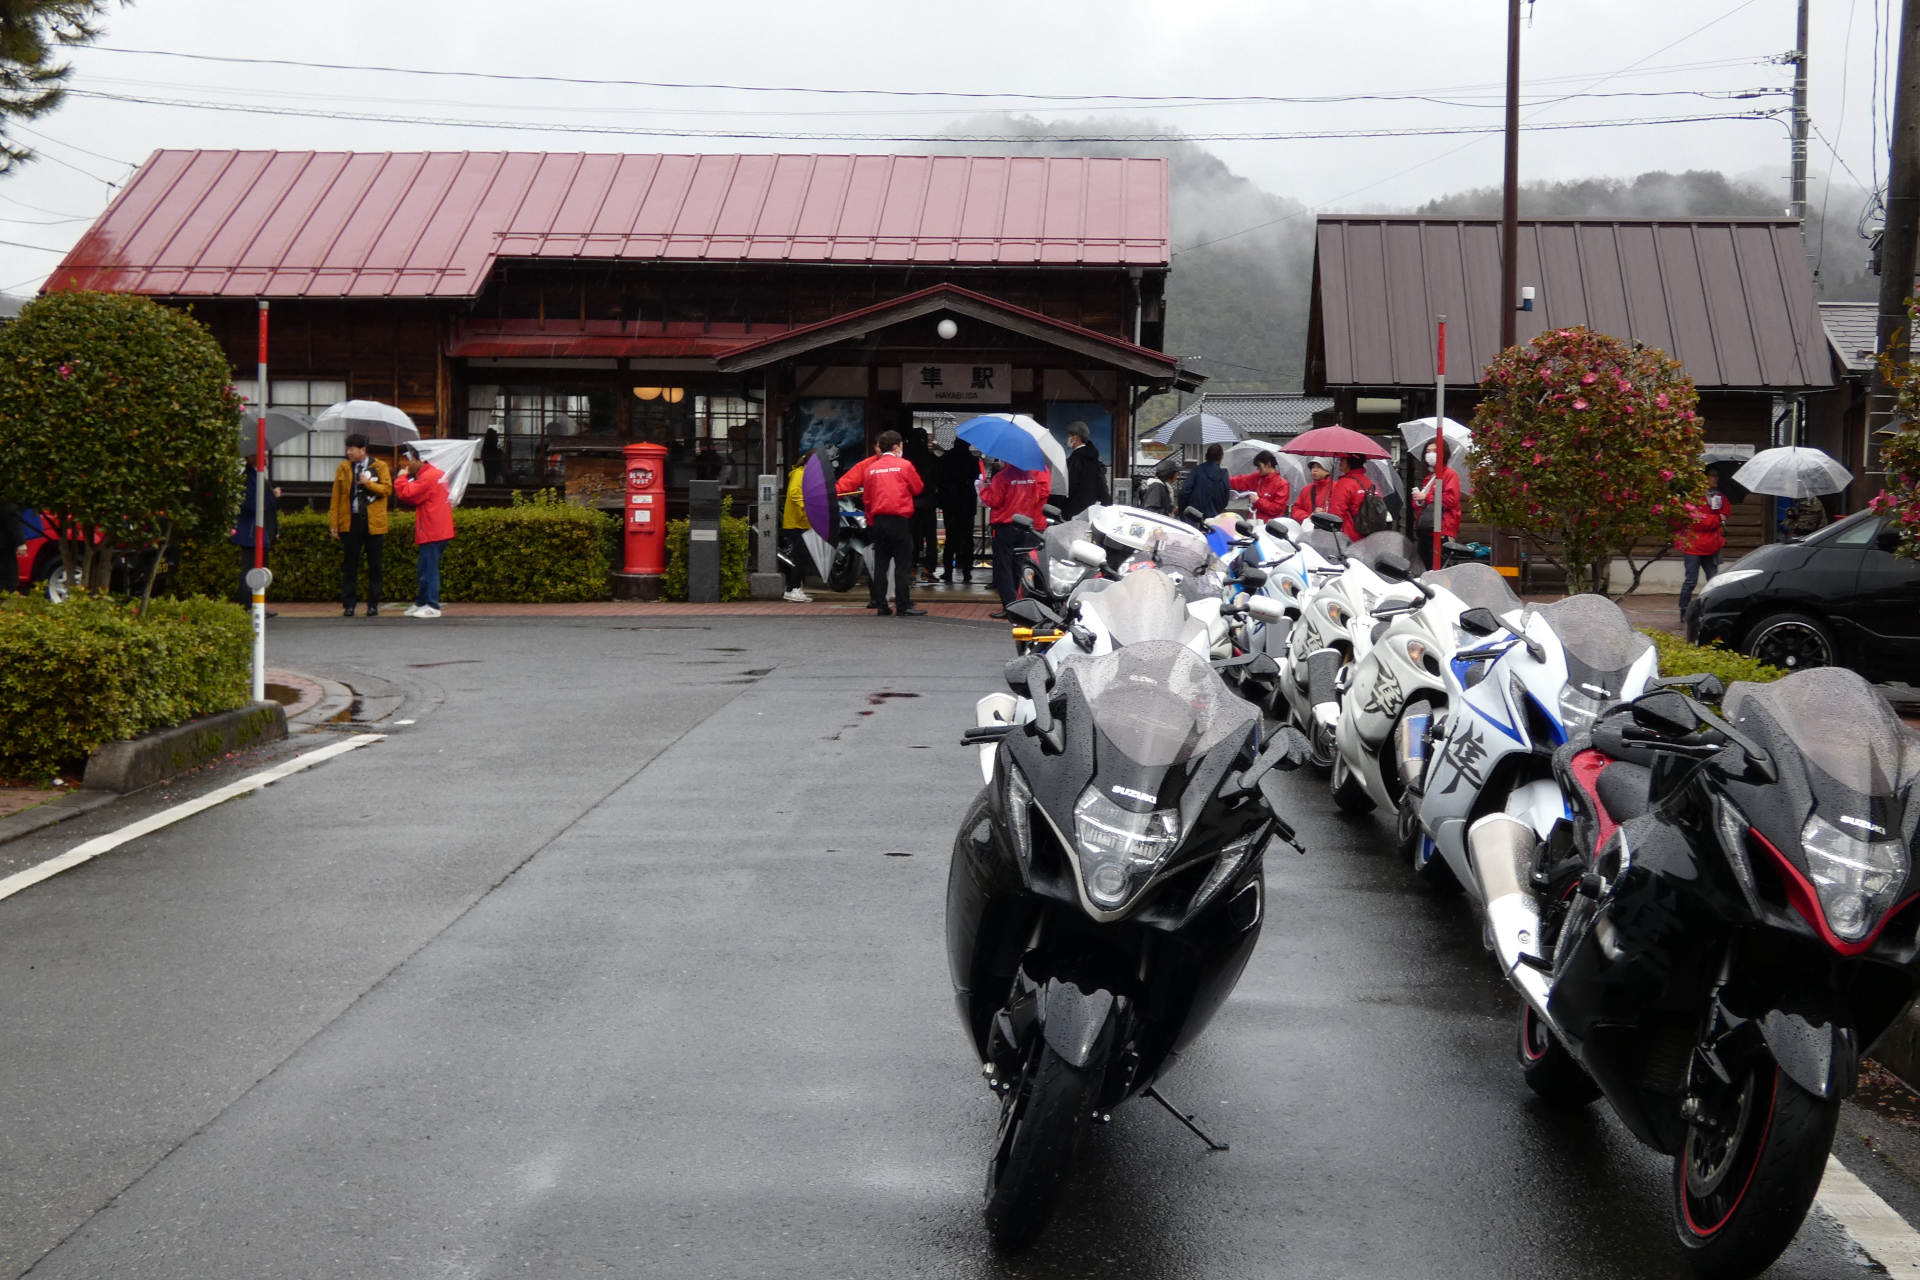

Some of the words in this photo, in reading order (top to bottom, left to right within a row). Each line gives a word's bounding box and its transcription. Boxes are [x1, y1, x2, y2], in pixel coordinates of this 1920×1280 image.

[935, 391, 979, 400] HAYABUSA
[1363, 655, 1404, 720] 隼
[1439, 719, 1488, 795] 隼
[1111, 785, 1157, 804] SUZUKI
[1839, 815, 1886, 835] SUZUKI
